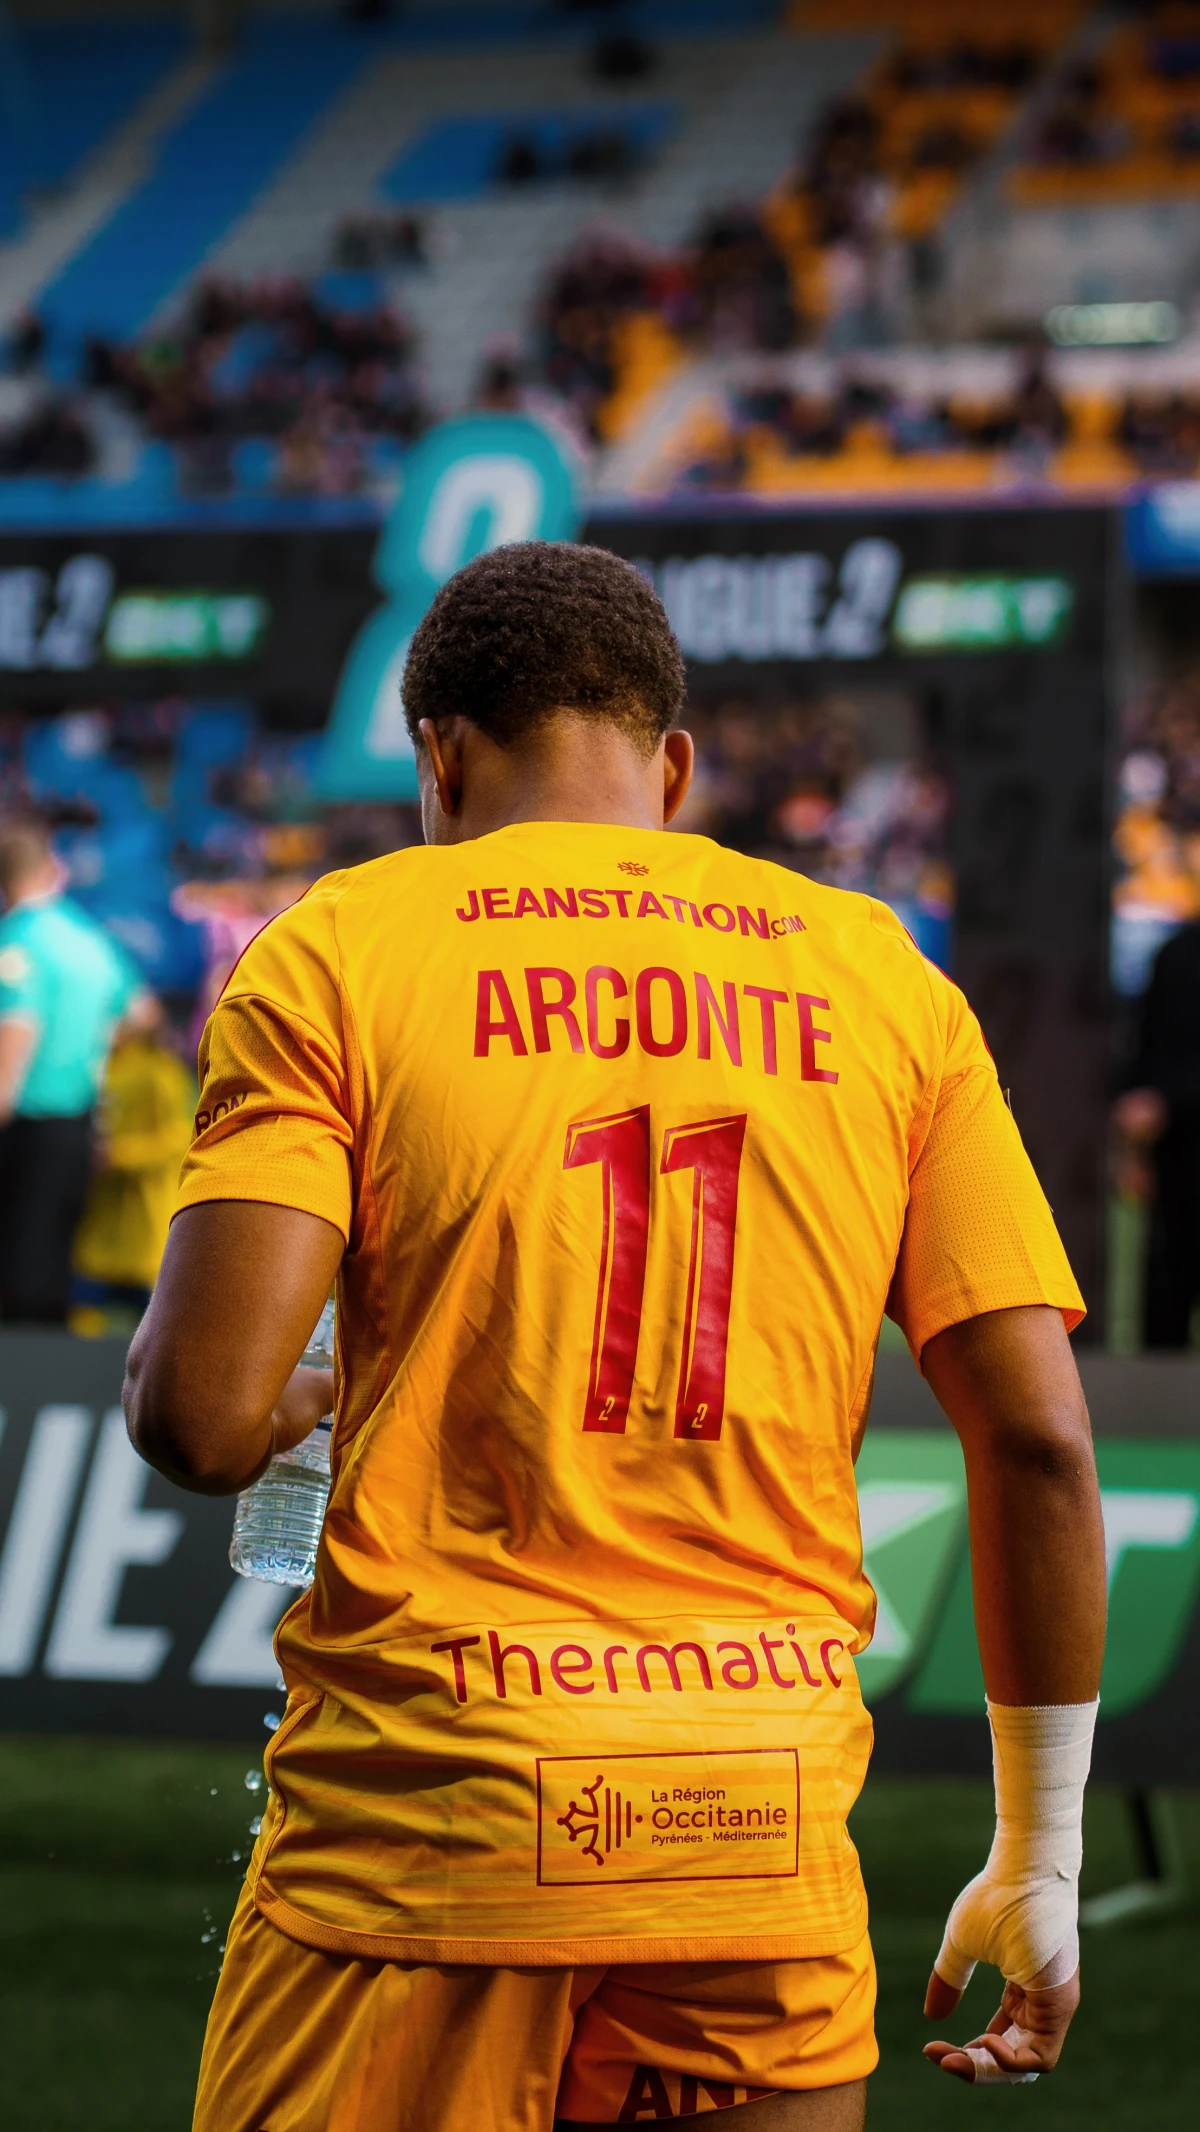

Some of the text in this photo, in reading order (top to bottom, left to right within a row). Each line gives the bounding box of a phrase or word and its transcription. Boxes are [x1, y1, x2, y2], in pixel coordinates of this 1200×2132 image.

[641, 552, 832, 664] IGUE
[473, 964, 840, 1085] ARCONTE
[563, 1104, 747, 1441] 11
[598, 1396, 615, 1421] 2
[691, 1403, 708, 1428] 2
[430, 1622, 845, 1704] Thermatic
[651, 1787, 726, 1804] La Région
[651, 1801, 787, 1830] Occitanie
[651, 1834, 703, 1846] Pyrénées
[713, 1830, 787, 1841] Méditerranée
[617, 2064, 784, 2122] AN
